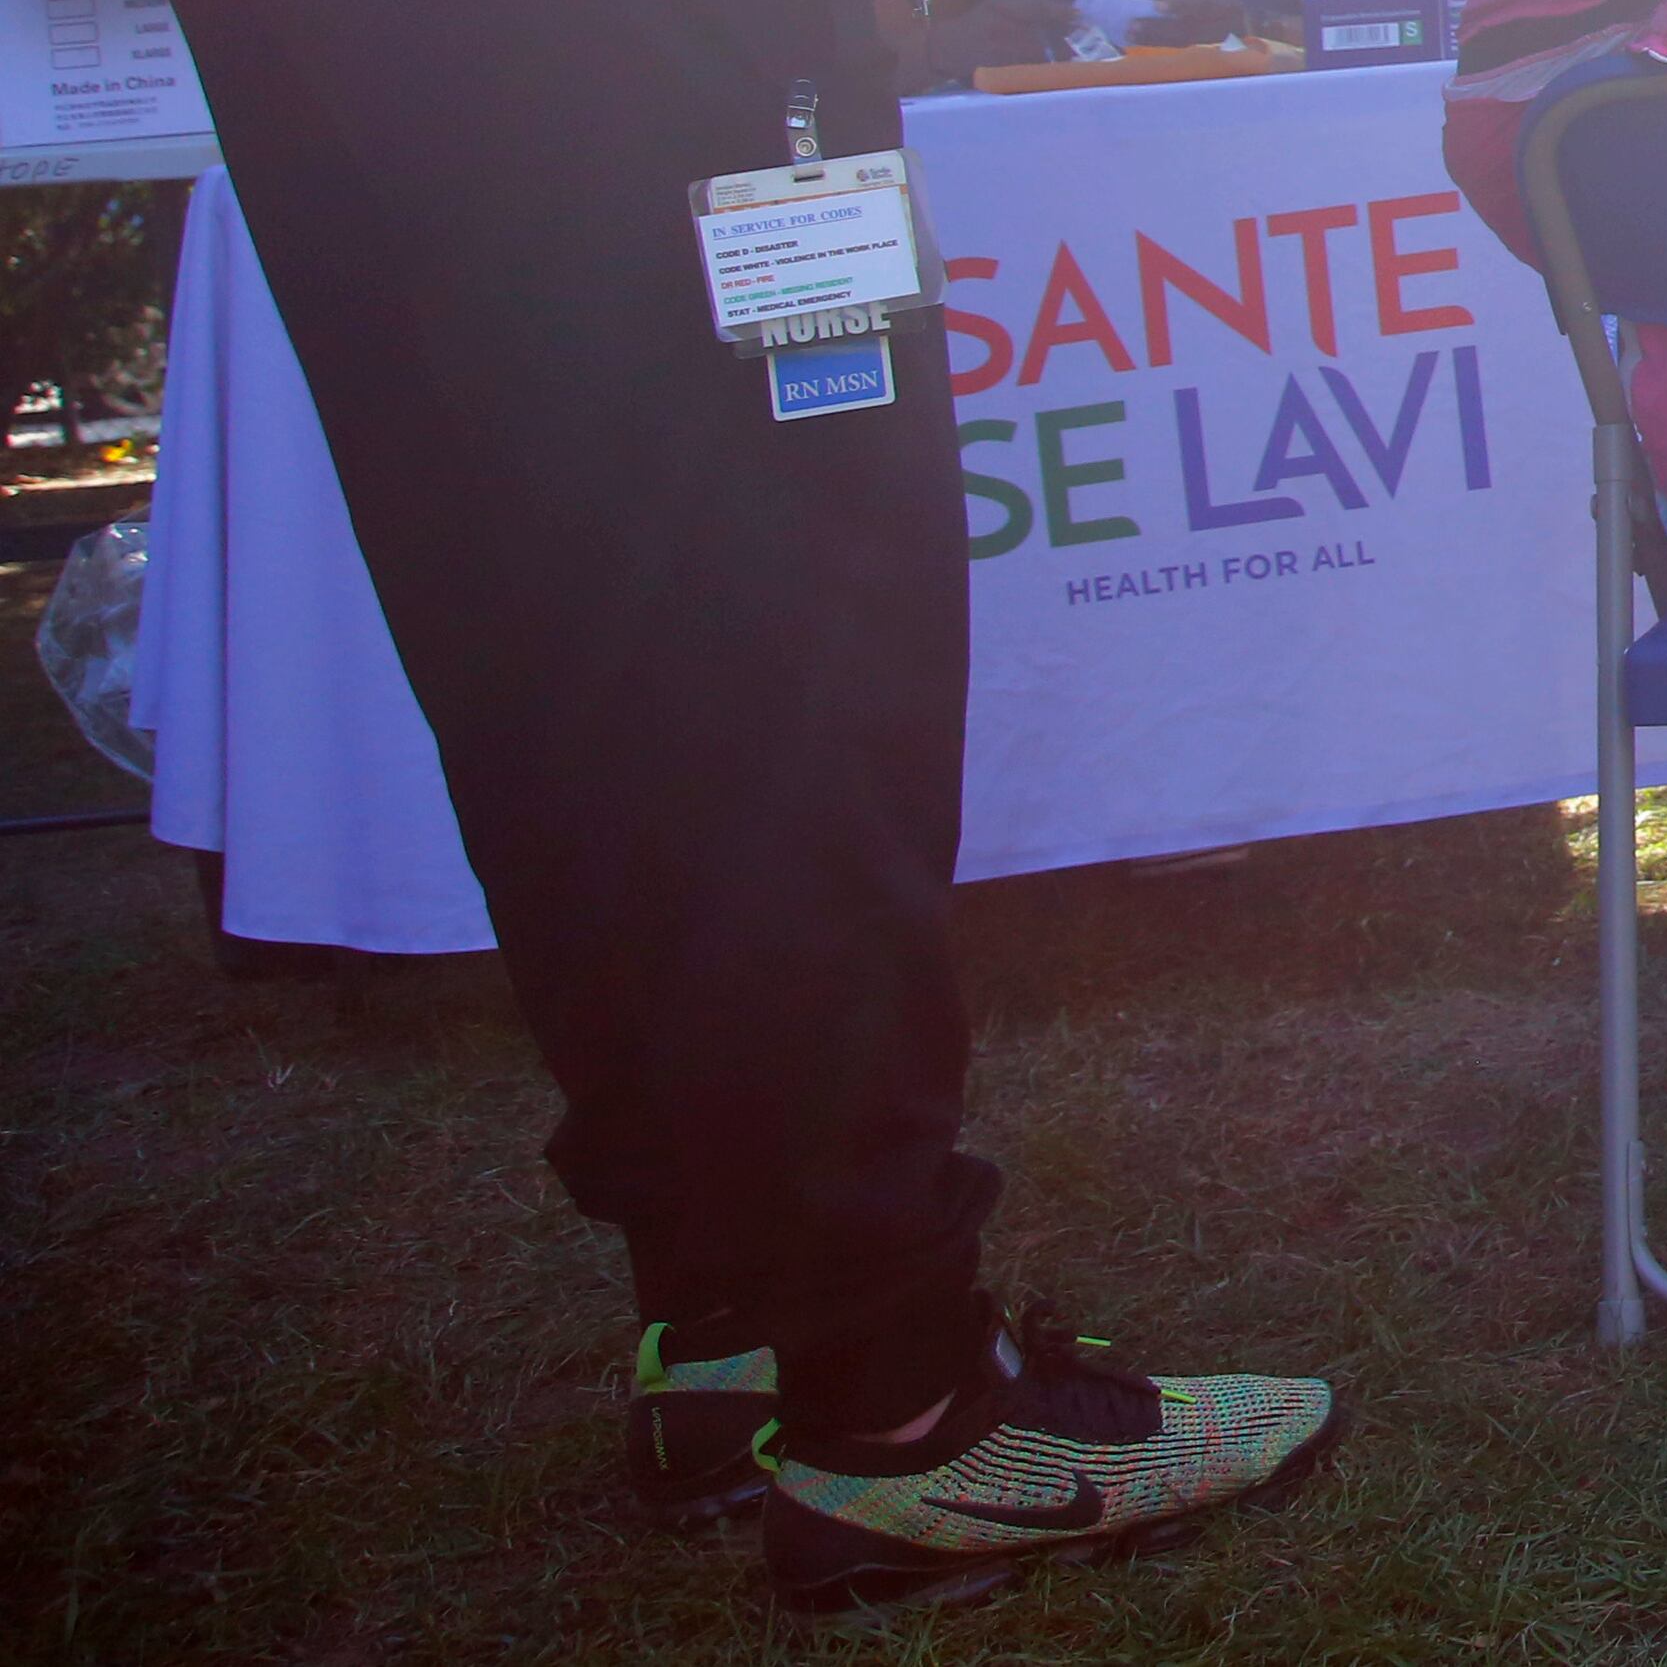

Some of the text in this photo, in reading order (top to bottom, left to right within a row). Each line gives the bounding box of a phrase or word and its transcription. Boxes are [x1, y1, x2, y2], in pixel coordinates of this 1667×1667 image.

[1406, 21, 1418, 37] S
[52, 76, 176, 96] Made in China
[712, 206, 863, 238] IN SERVICE FOR CODES
[716, 250, 740, 260] CODE
[755, 240, 799, 253] DISASTER
[719, 265, 742, 275] CODE
[742, 260, 770, 271] WHITE
[775, 253, 816, 265] VIOLENCE
[827, 248, 845, 256] THE
[845, 244, 871, 254] WORK
[871, 239, 898, 249] PLACE
[721, 281, 733, 289] DR
[734, 278, 751, 287] RED
[756, 274, 775, 284] FIRE
[944, 190, 1475, 397] SANTE
[724, 295, 747, 304] CODE
[728, 307, 751, 317] STAT
[757, 301, 796, 312] MEDICAL
[797, 290, 852, 305] EMERGENCY
[761, 301, 891, 347] NURSE
[784, 370, 878, 402] RN MSN
[958, 344, 1492, 561] SE LAVI
[1066, 540, 1375, 605] HEALTH FOR ALL
